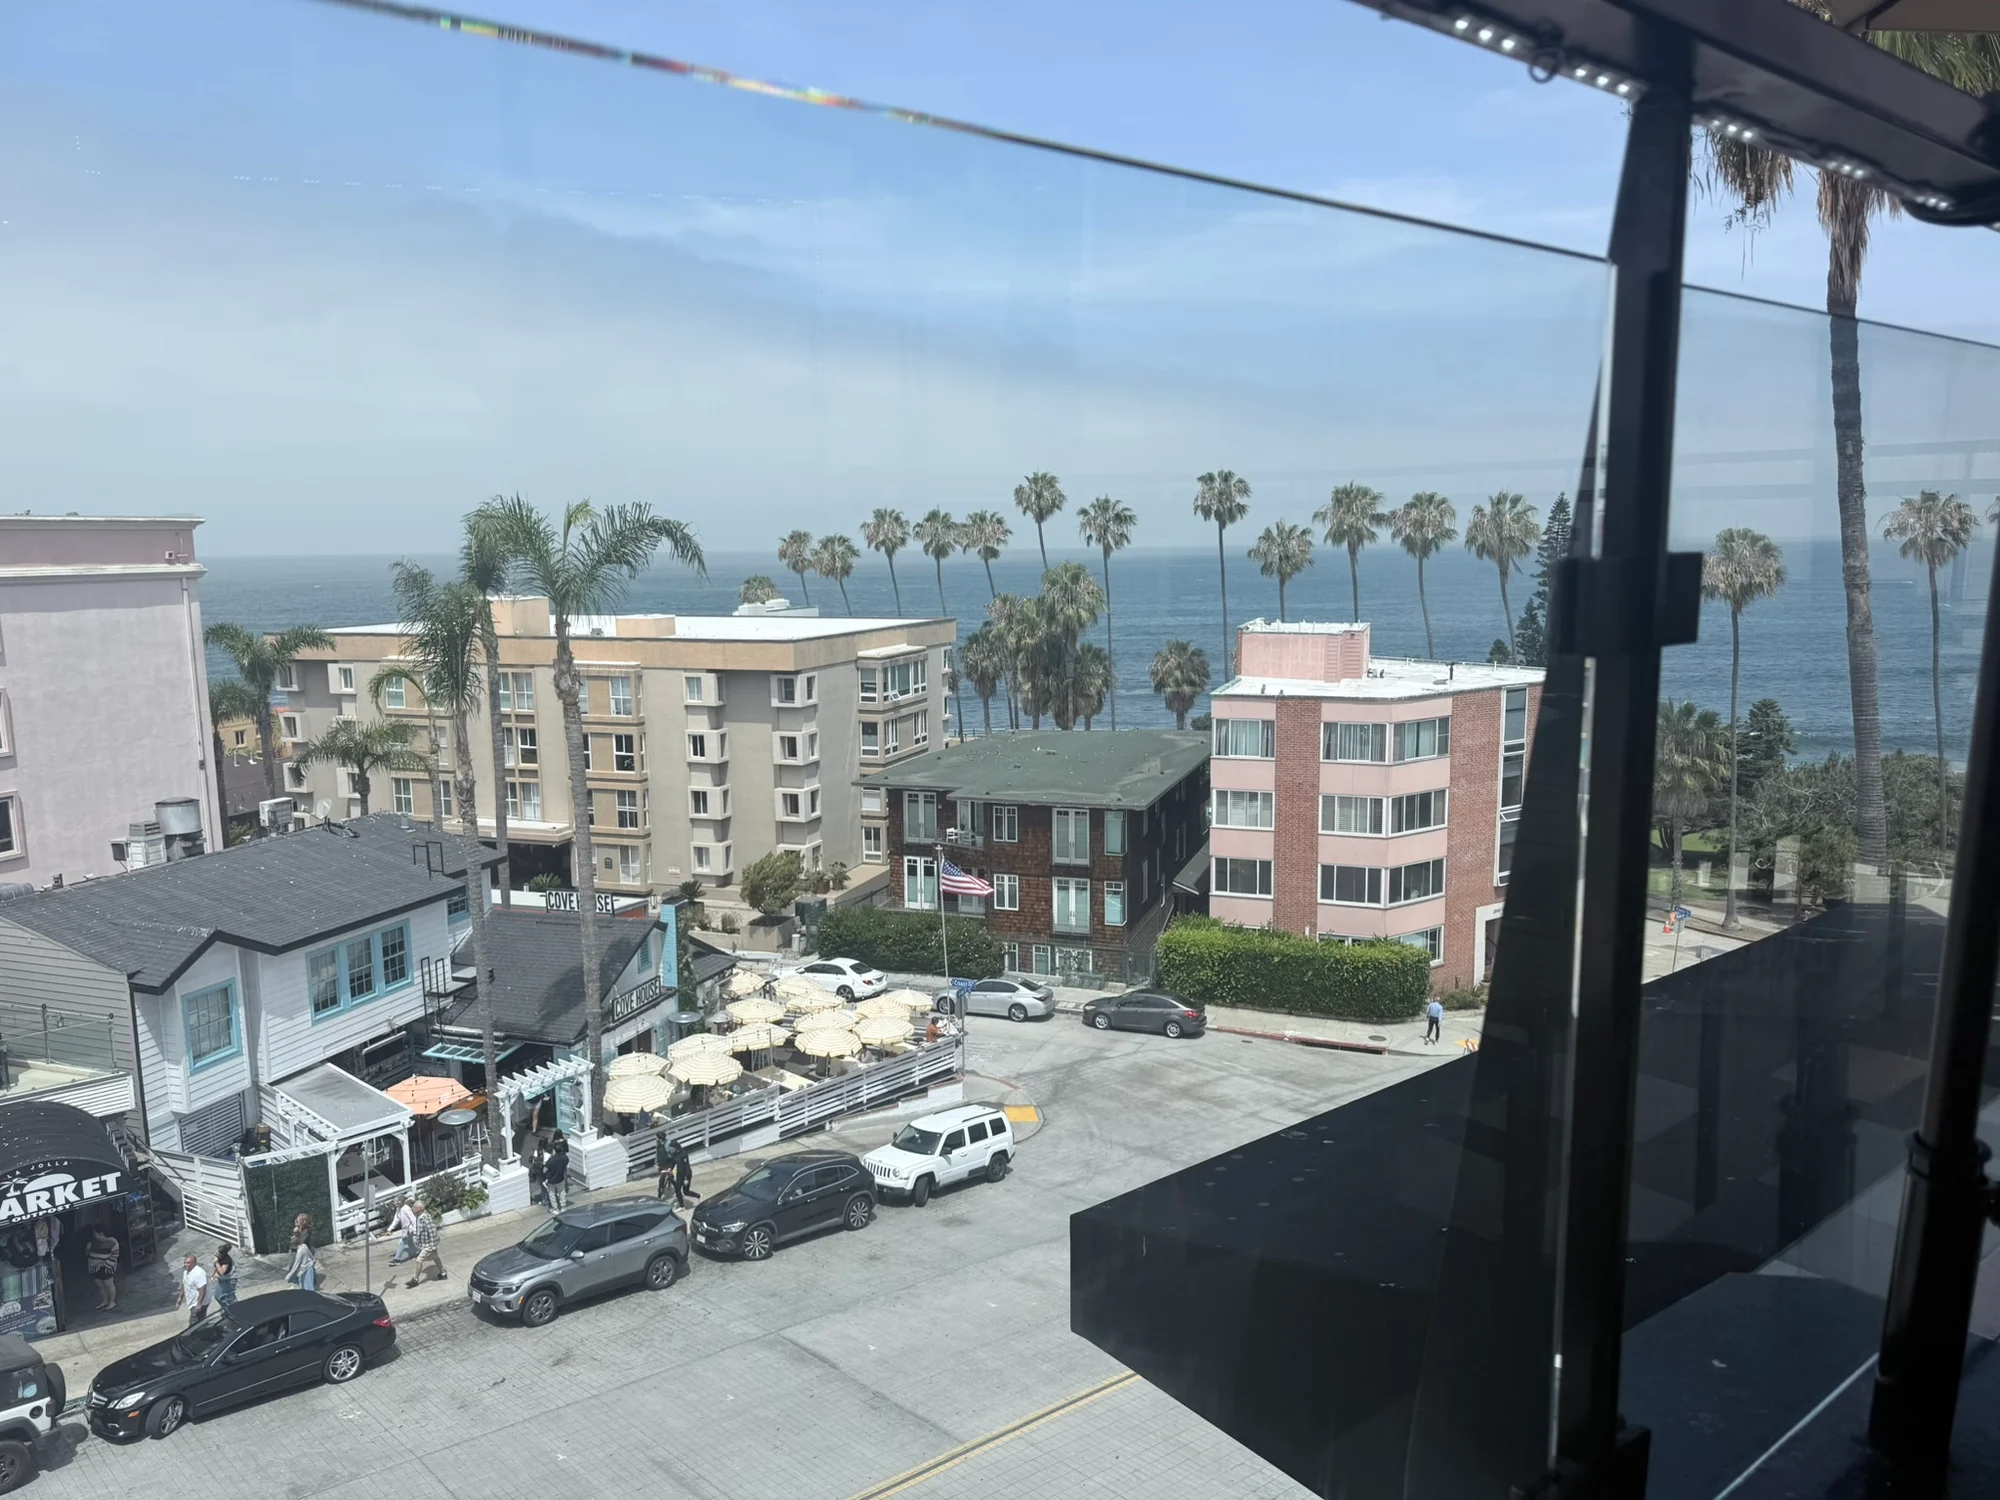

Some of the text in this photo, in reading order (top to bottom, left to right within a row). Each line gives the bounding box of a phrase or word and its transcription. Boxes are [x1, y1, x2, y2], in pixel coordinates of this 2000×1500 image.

[548, 891, 575, 910] COVE
[615, 979, 659, 1018] COVE HOUSE
[7, 1160, 68, 1179] LA JOLLA
[0, 1171, 121, 1221] ARKET
[11, 1203, 71, 1223] OUTPOST
